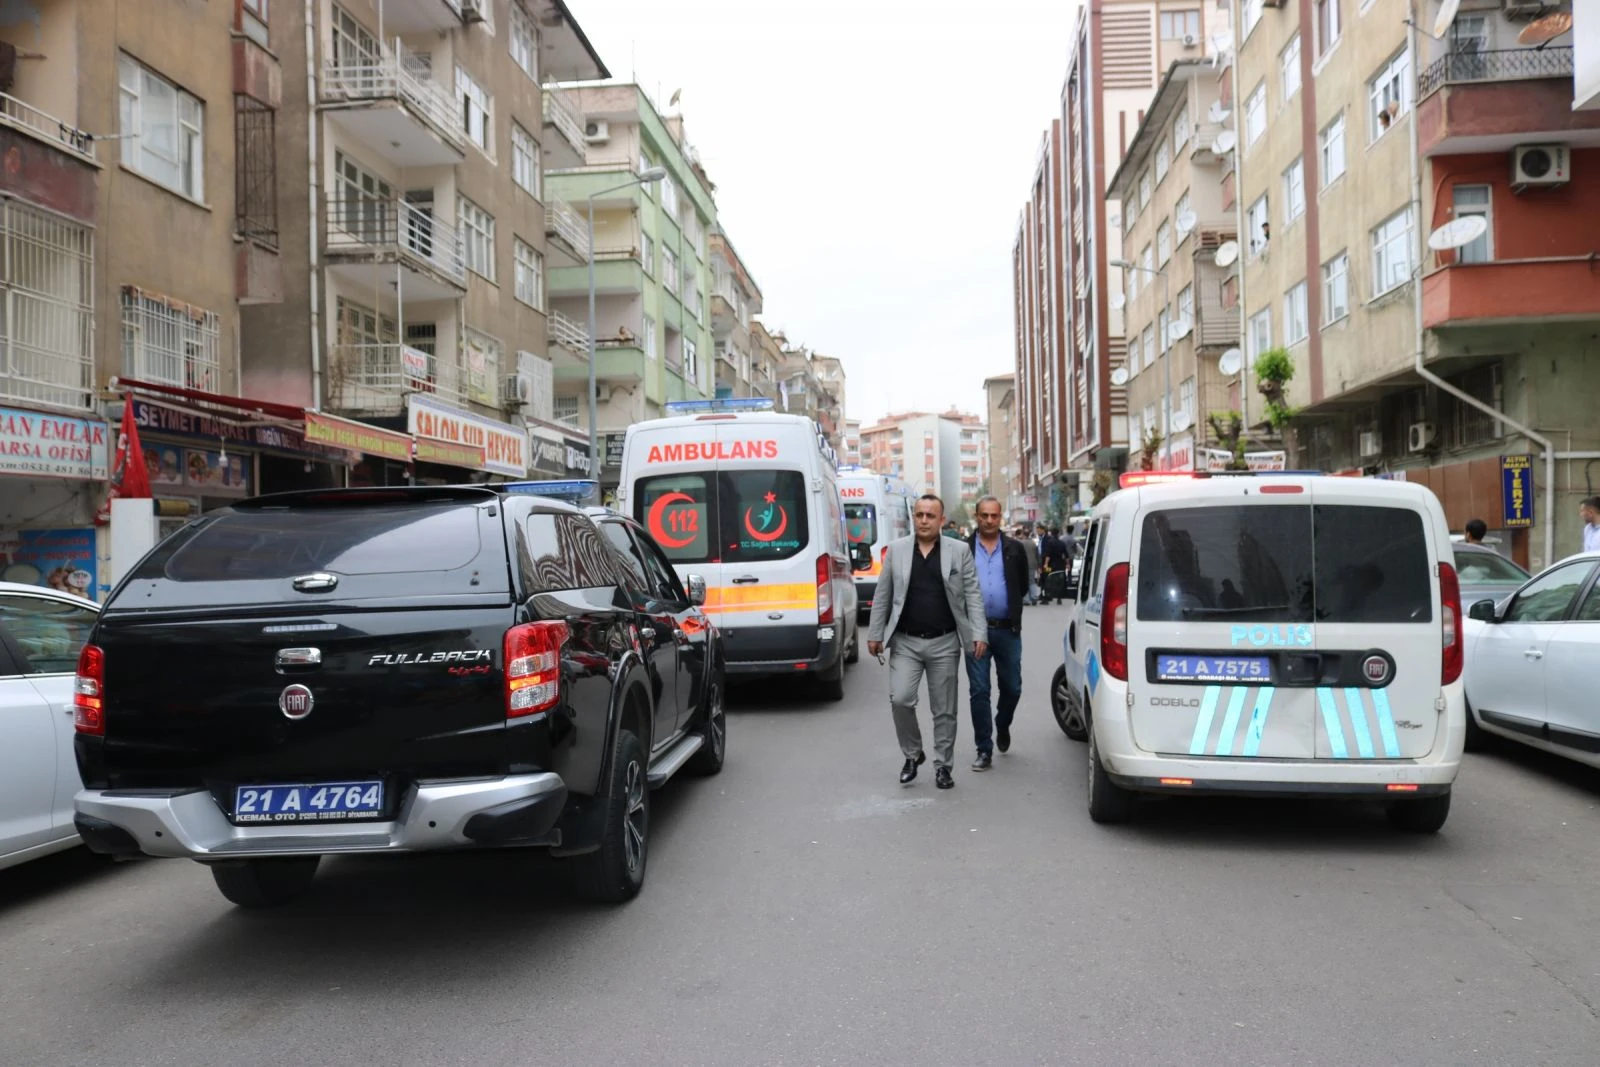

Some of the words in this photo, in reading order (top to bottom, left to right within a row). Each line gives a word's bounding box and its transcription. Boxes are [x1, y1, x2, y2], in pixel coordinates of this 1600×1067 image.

[139, 404, 195, 433] SEYMET
[0, 415, 34, 436] AN
[40, 419, 104, 446] EMLAK
[647, 440, 778, 463] AMBULANS
[668, 509, 698, 532] 112
[368, 649, 491, 666] FULLBACK
[1166, 660, 1188, 674] 21
[1195, 660, 1209, 674] A
[1214, 660, 1261, 676] 7575
[1369, 663, 1384, 675] FIAT
[287, 694, 306, 710] FIAT
[1150, 697, 1200, 707] DOBLO
[239, 789, 273, 812] 21
[281, 788, 301, 811] A
[310, 785, 379, 810] 4764
[236, 813, 272, 822] KEMAL
[275, 812, 296, 821] OTO
